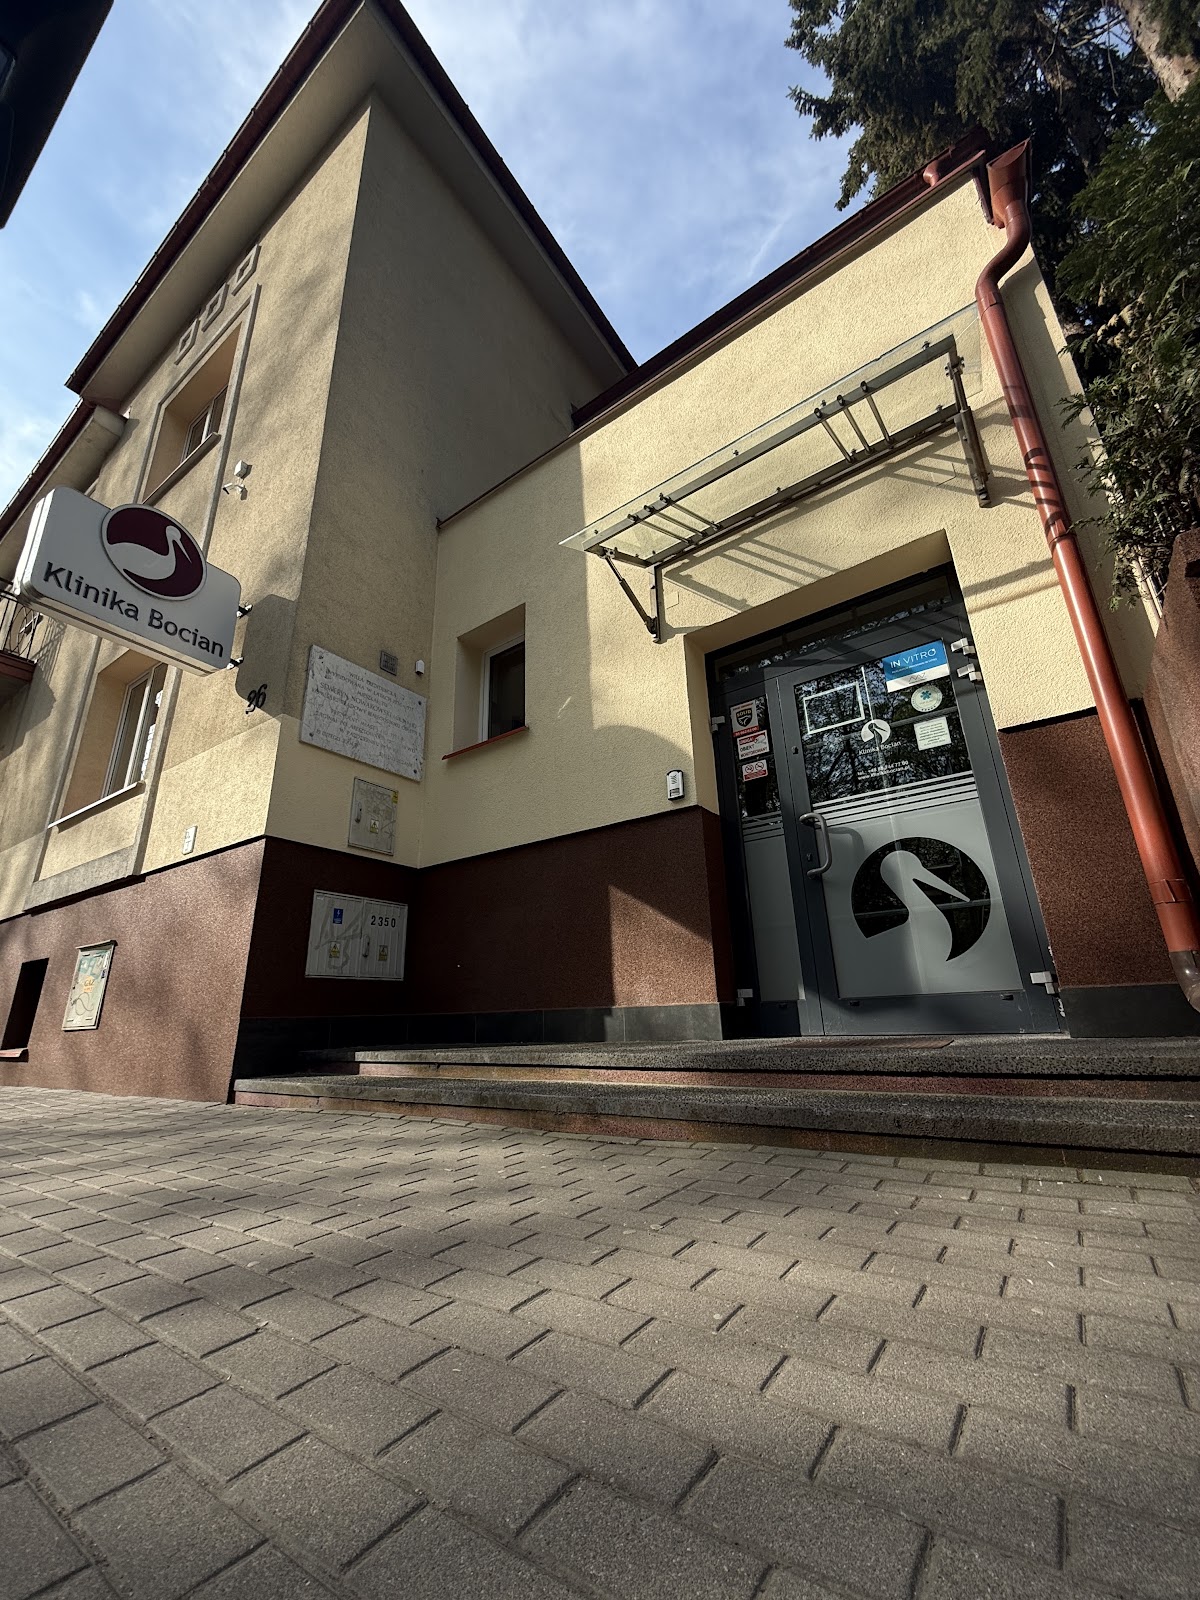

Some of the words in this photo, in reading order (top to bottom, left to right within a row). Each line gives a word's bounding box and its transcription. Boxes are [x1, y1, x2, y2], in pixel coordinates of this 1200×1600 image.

[43, 561, 139, 622] Klinika
[147, 608, 224, 658] Bocian
[890, 659, 901, 669] IN
[903, 648, 937, 664] VITRO
[736, 709, 752, 718] SOLID
[370, 914, 397, 928] 2350
